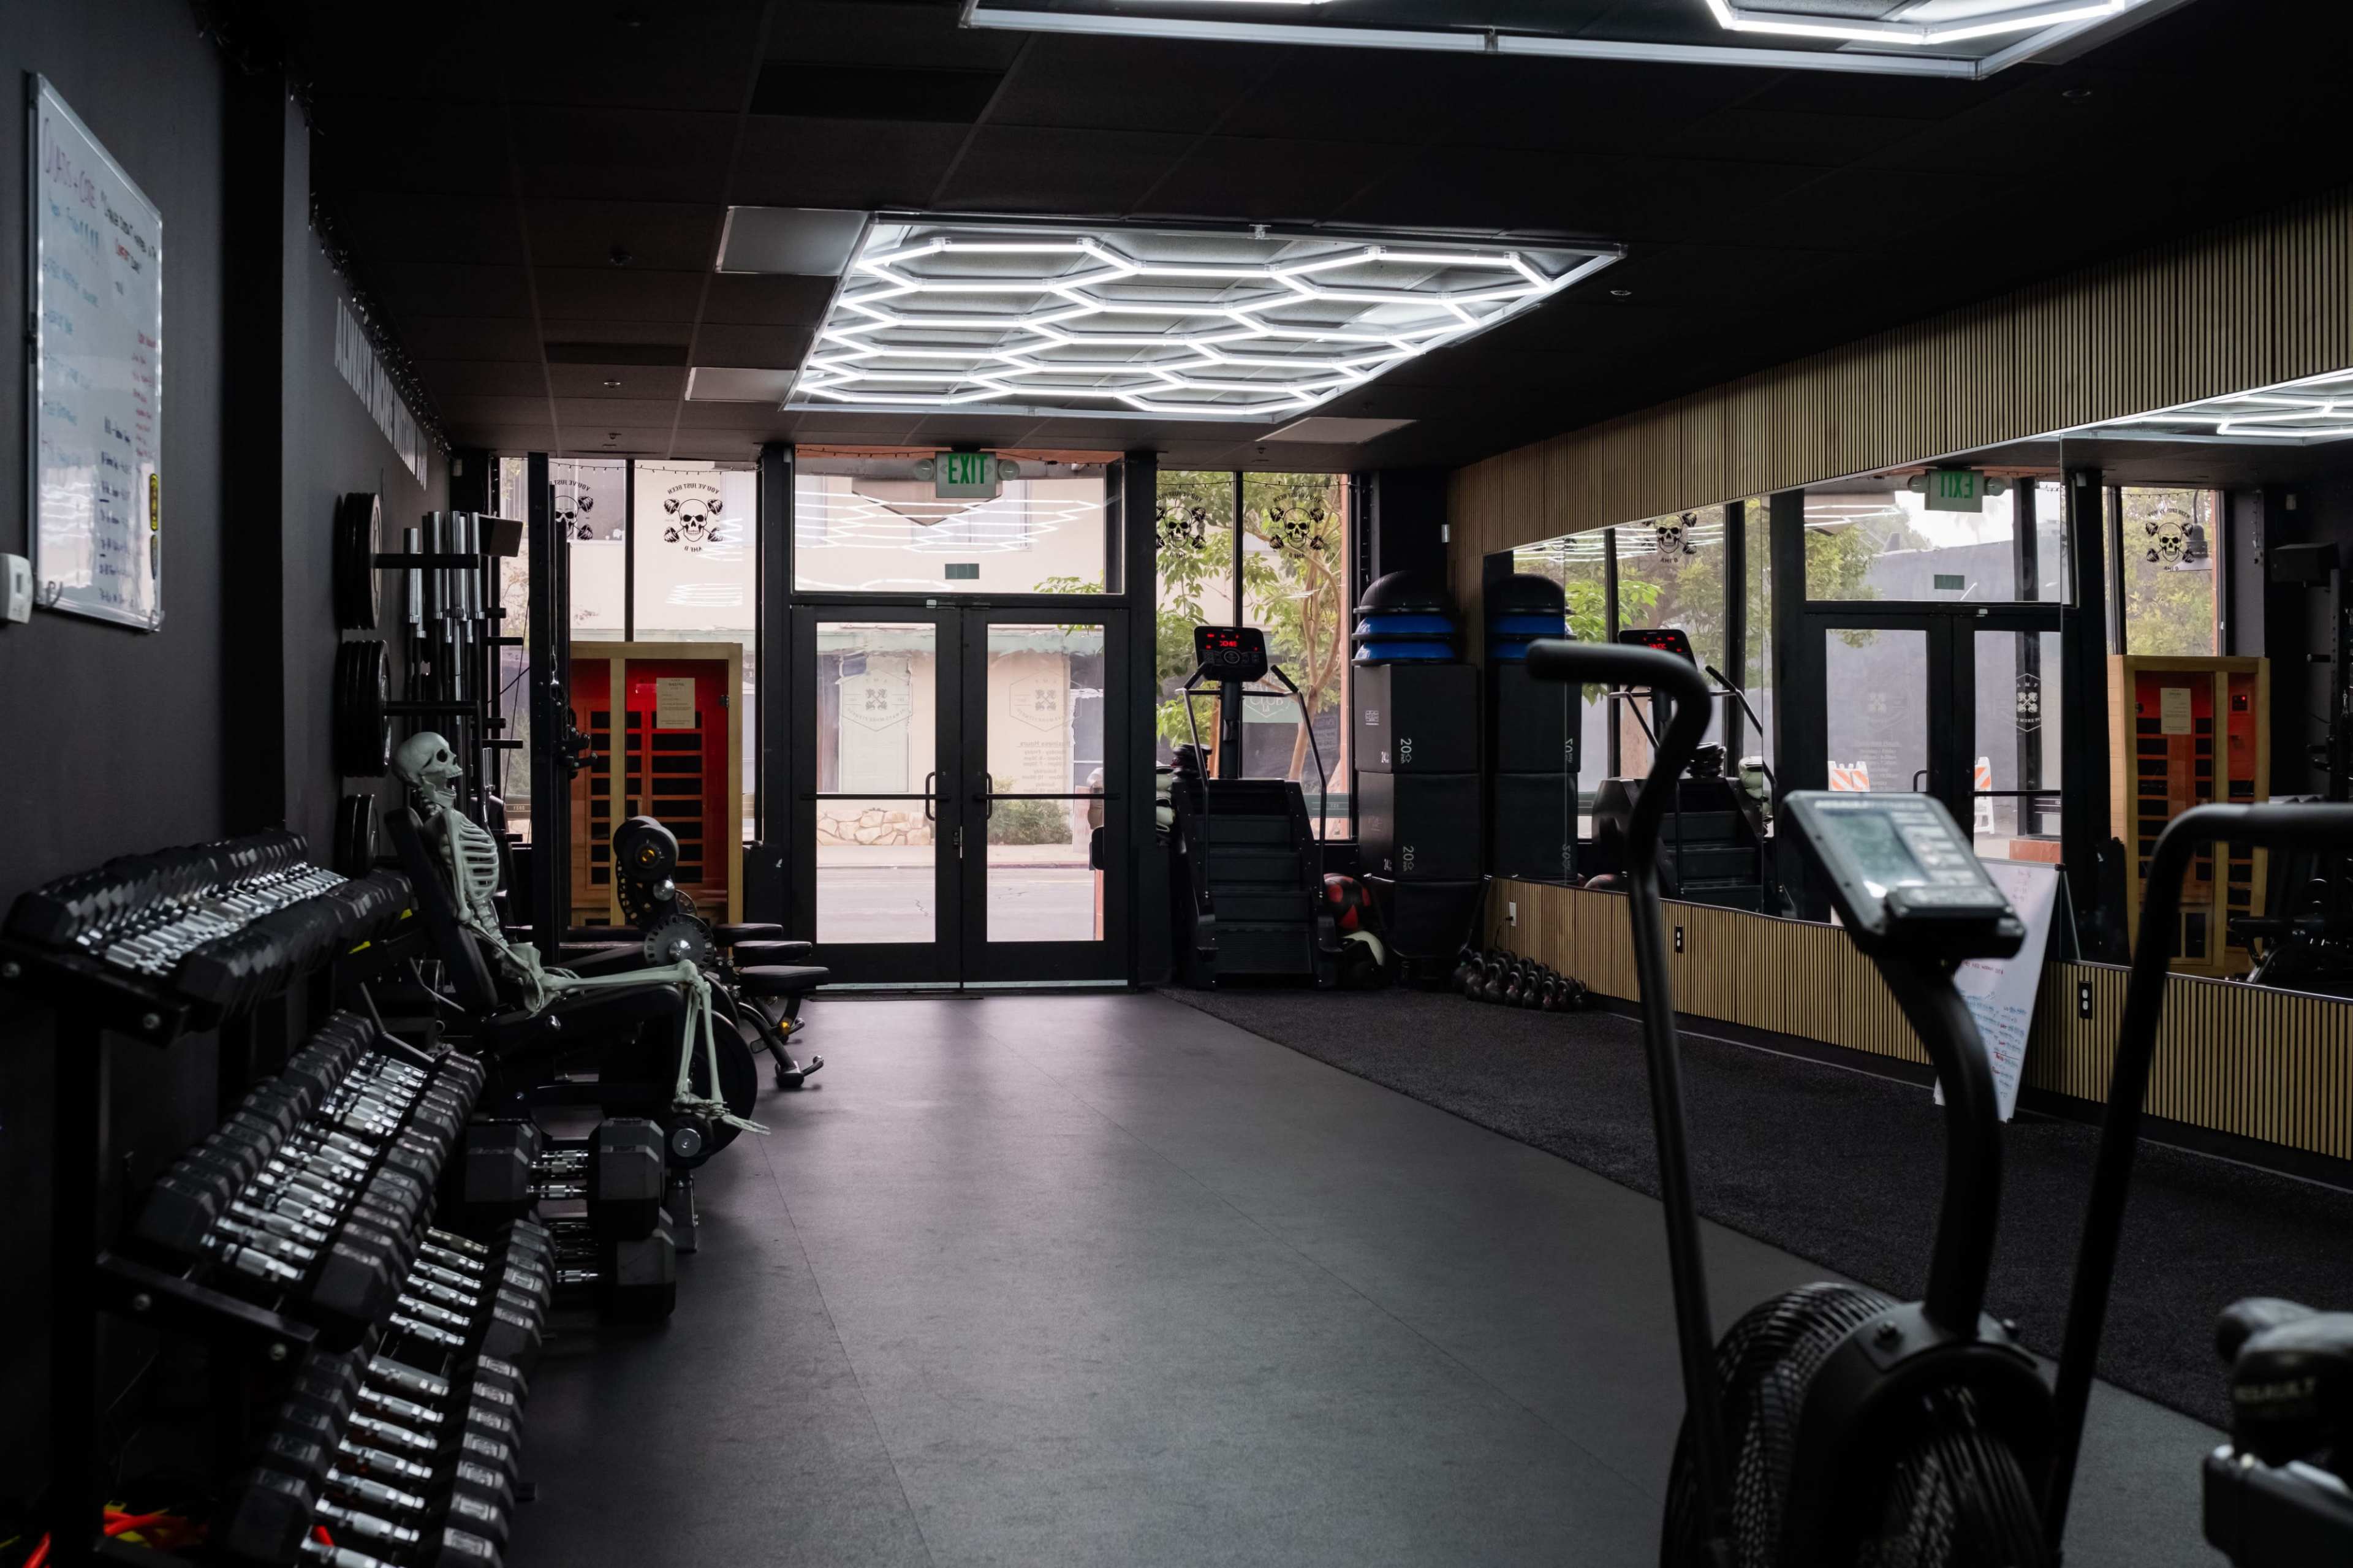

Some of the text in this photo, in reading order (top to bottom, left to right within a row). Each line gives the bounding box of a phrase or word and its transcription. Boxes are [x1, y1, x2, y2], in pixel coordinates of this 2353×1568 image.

[335, 296, 372, 414] ALWAYS
[373, 355, 393, 444] MORE
[948, 454, 988, 484] EXIT
[1401, 738, 1412, 754] 20
[1403, 845, 1414, 861] 20
